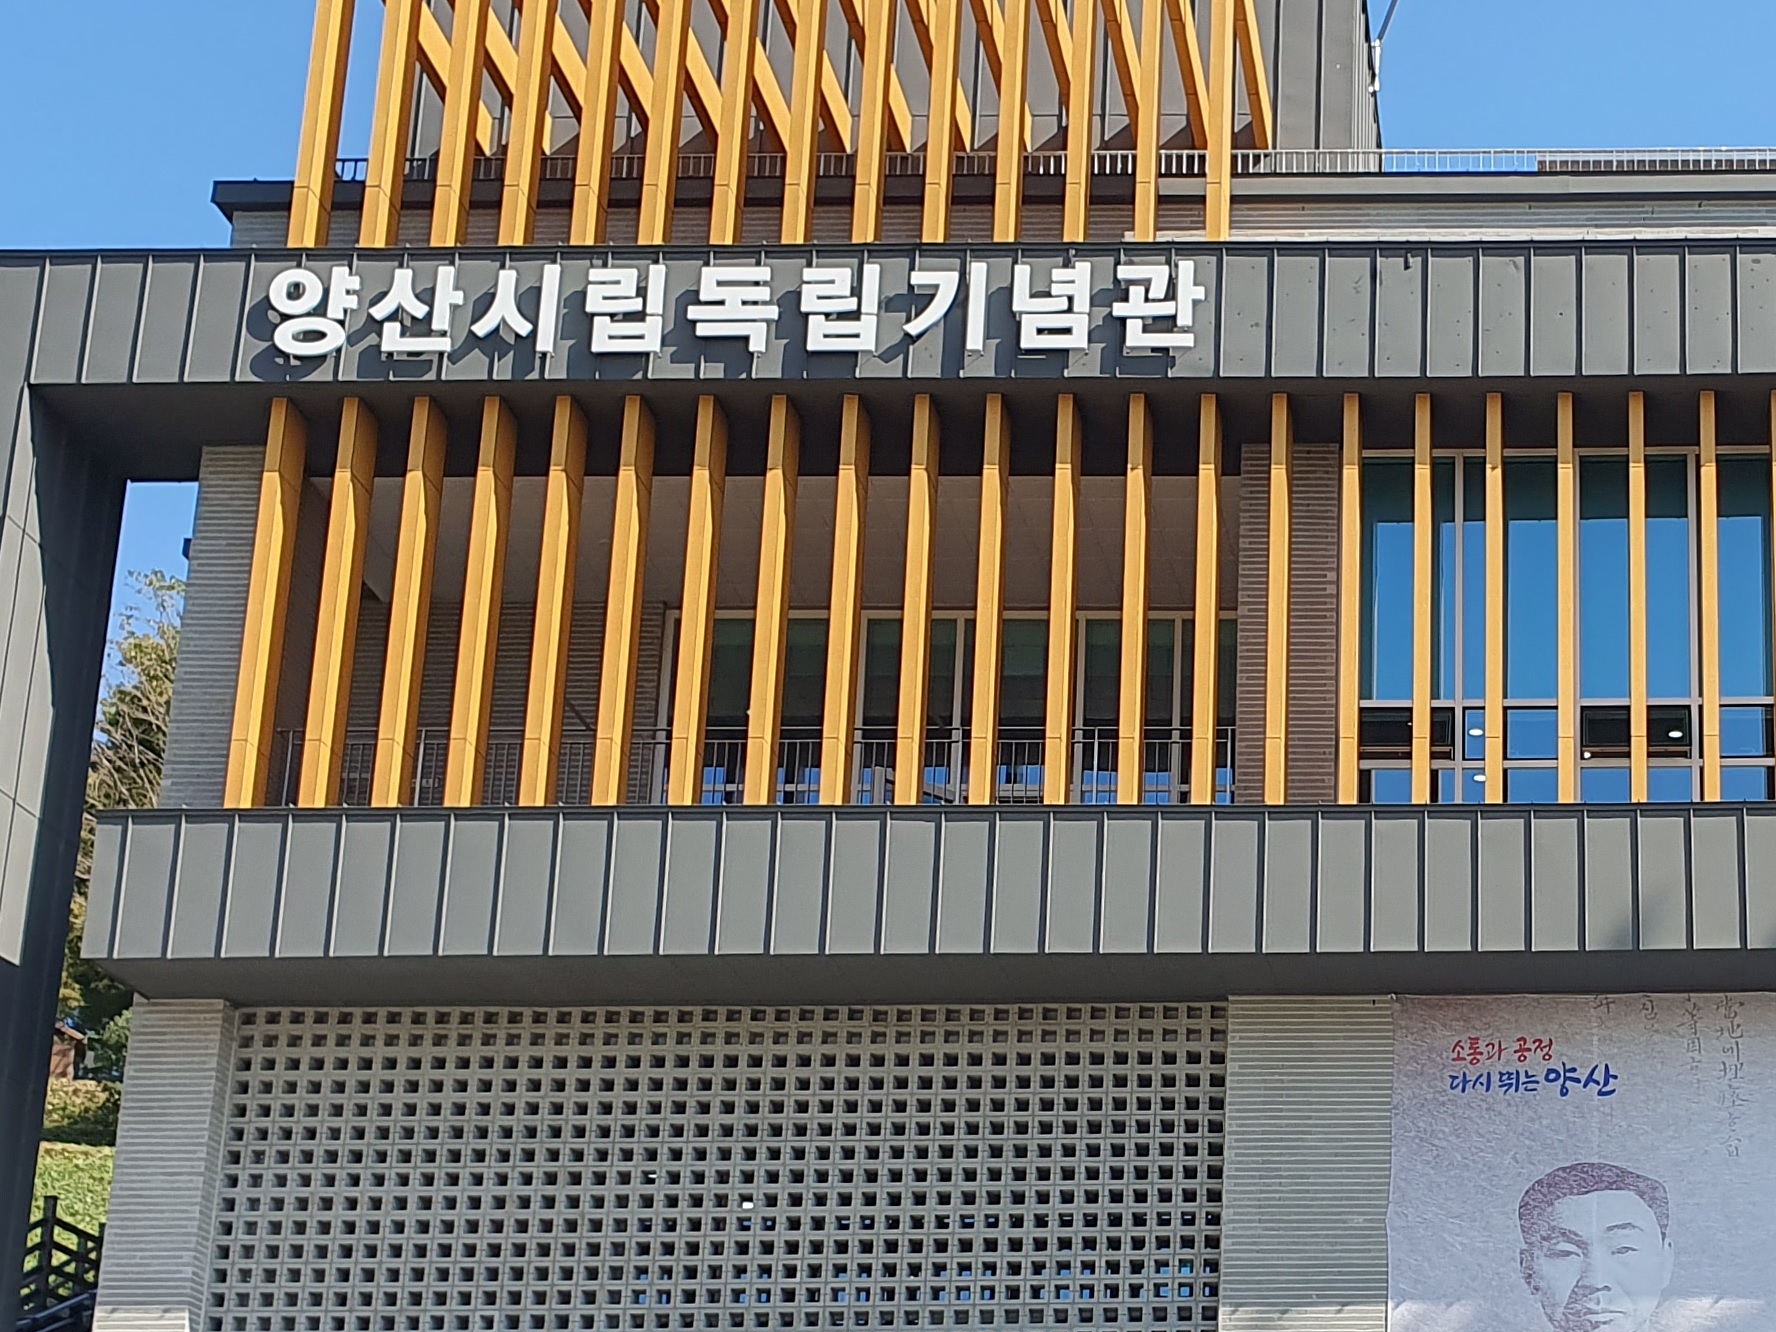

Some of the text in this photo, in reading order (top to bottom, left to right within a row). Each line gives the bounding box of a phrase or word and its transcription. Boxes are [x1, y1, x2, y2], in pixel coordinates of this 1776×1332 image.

[268, 261, 1206, 357] 양산시립독립기념관
[1452, 1036, 1553, 1065] 소통과 공정
[1449, 1061, 1619, 1097] 다시 뛰는 양산
